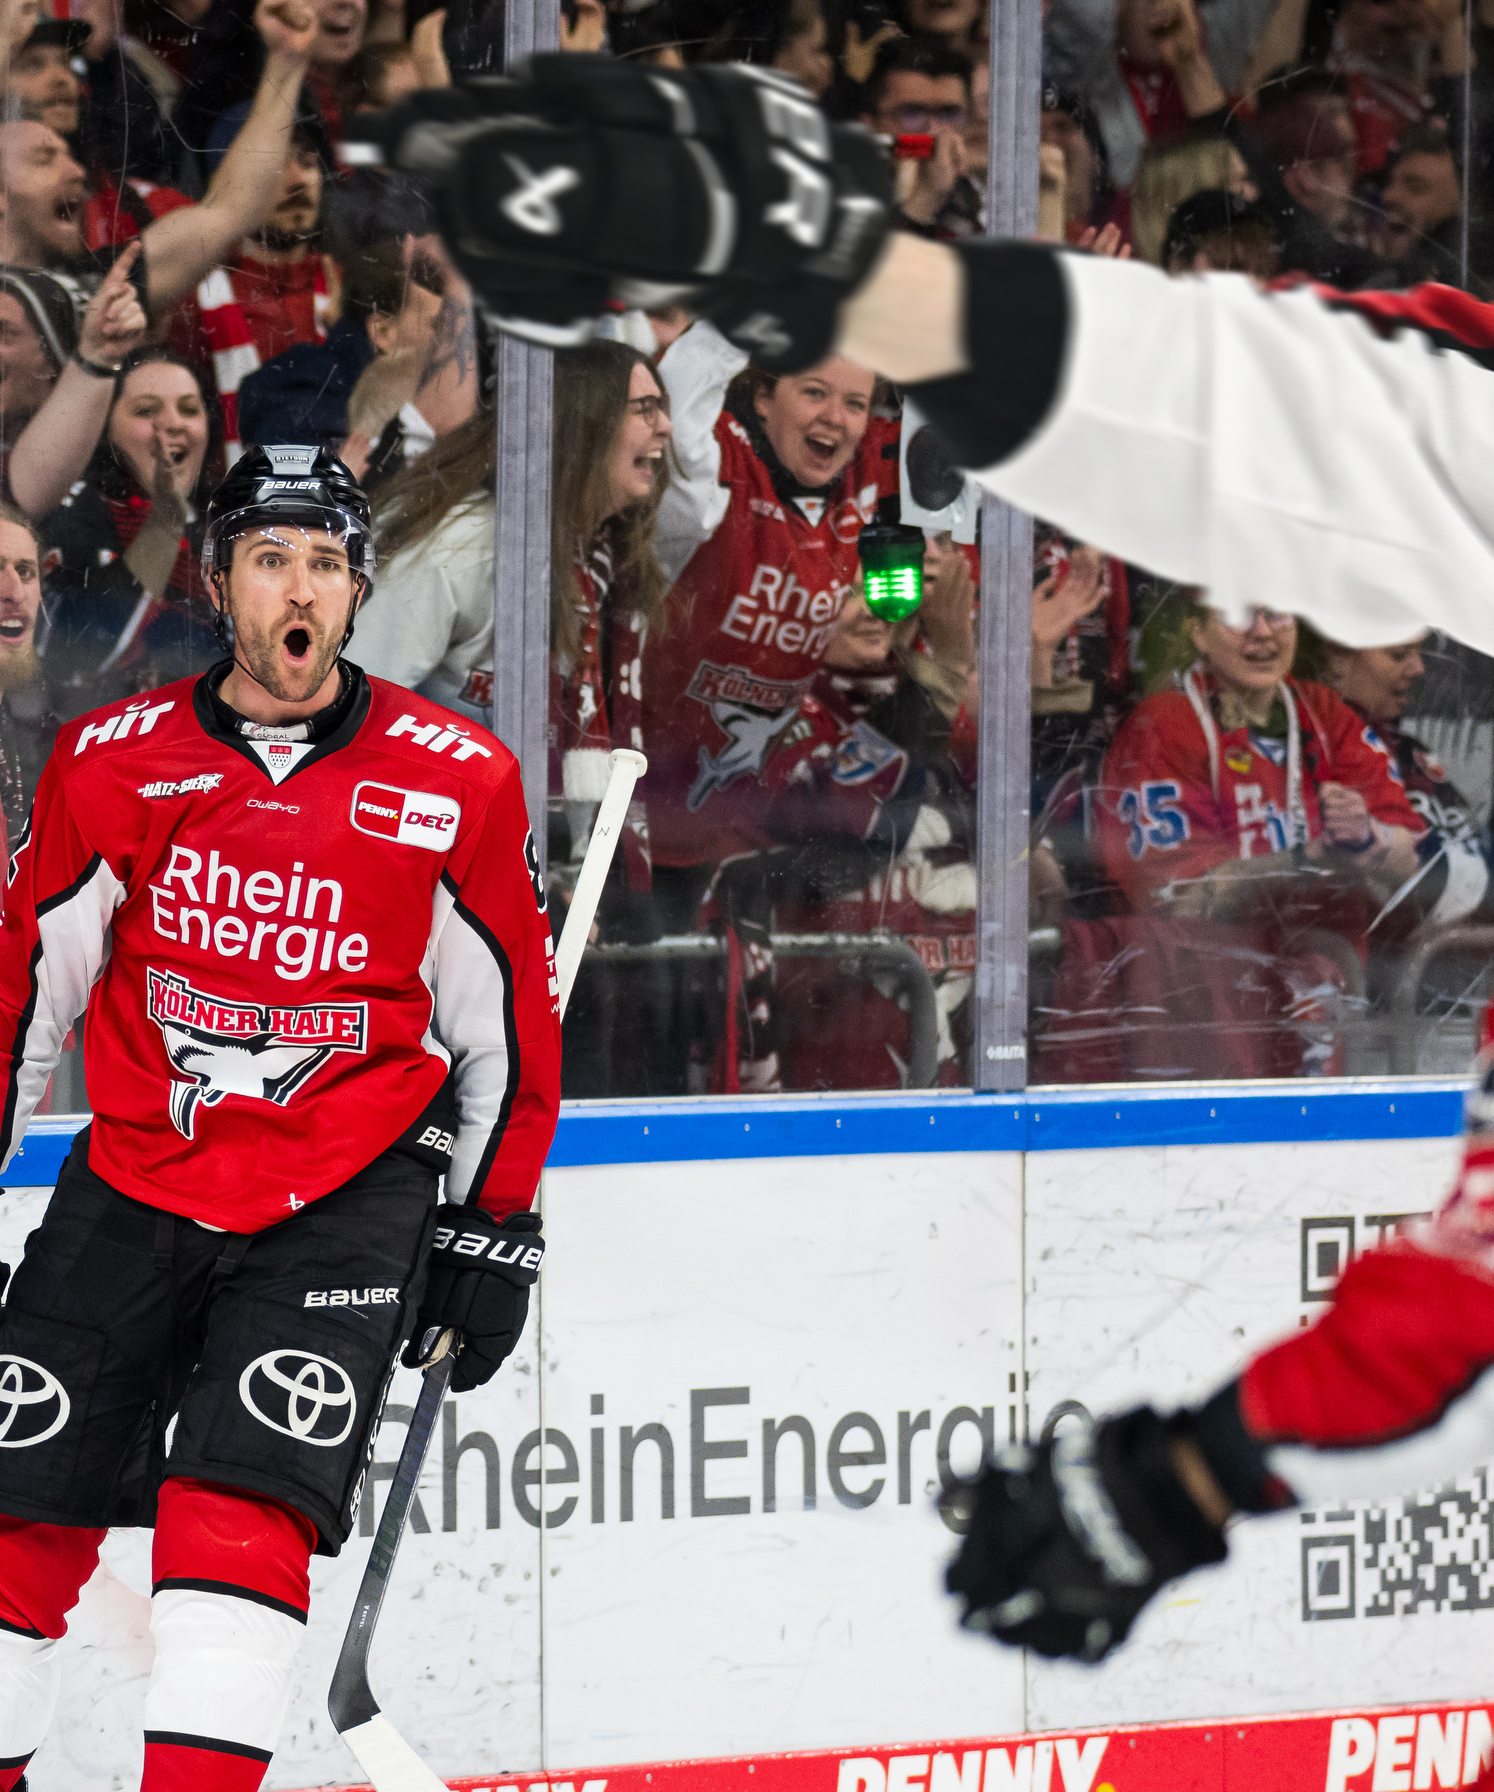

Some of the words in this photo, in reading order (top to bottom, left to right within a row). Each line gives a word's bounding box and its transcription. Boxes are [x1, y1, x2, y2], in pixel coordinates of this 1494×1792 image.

[262, 481, 321, 490] BAUER
[163, 844, 343, 923] Rhein
[148, 884, 369, 981] Energie
[151, 977, 259, 1032] KÖLNER
[270, 1008, 361, 1044] HAIE
[432, 1227, 545, 1272] BAUE
[304, 1287, 400, 1308] BAUER
